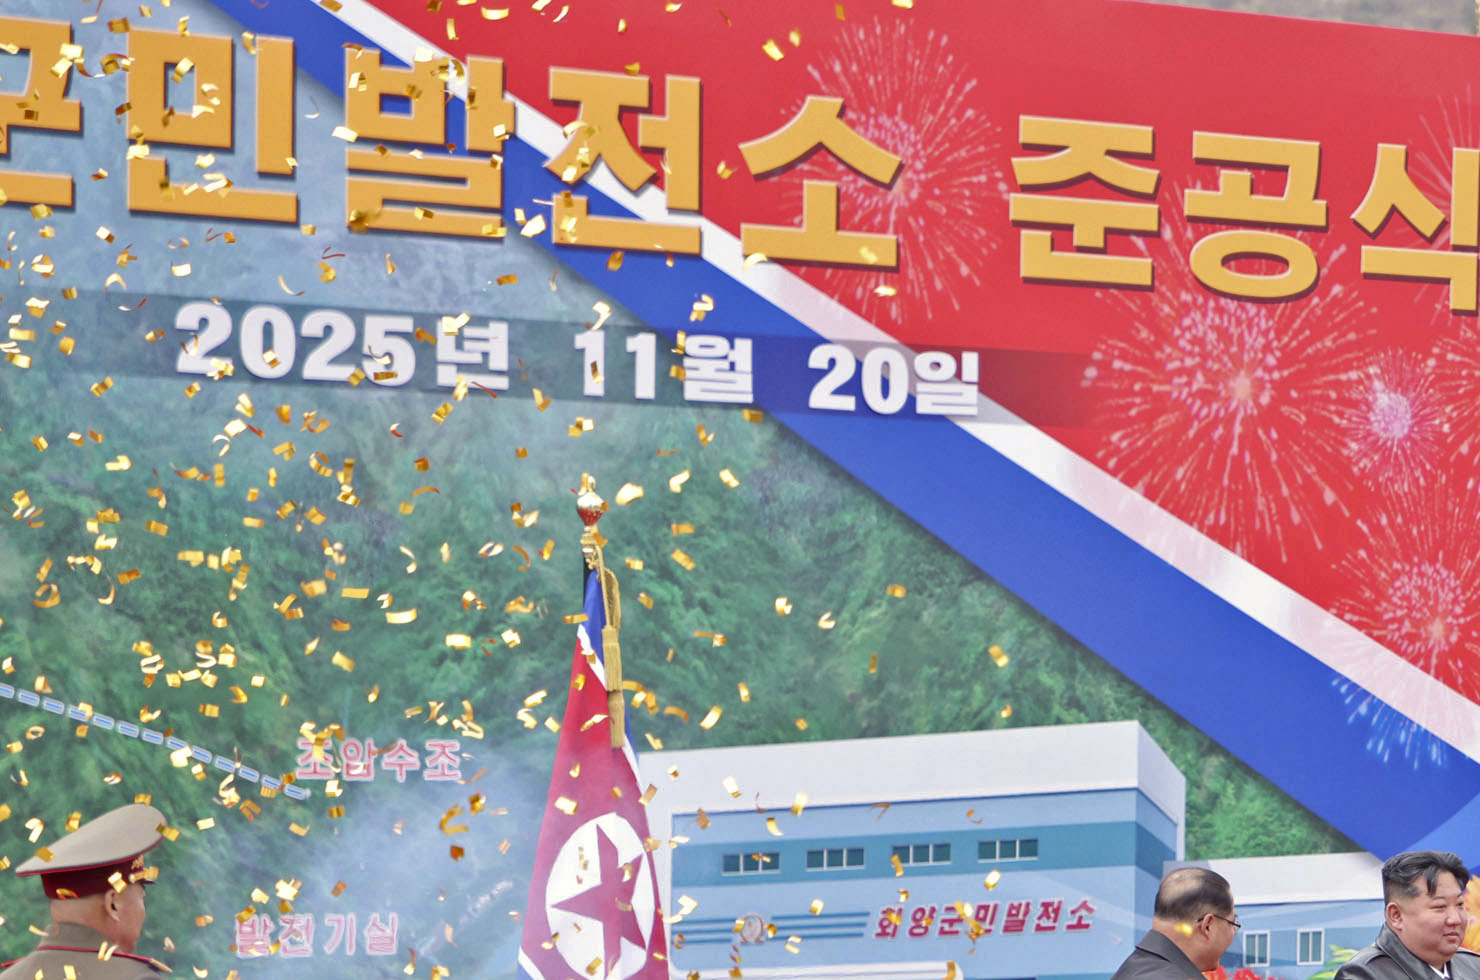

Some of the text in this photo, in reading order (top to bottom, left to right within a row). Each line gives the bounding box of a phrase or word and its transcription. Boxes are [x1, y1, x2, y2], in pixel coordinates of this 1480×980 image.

[1009, 115, 1480, 313] 준공식
[174, 301, 980, 417] 2025년 11월 20일
[235, 911, 399, 959] 발전기실
